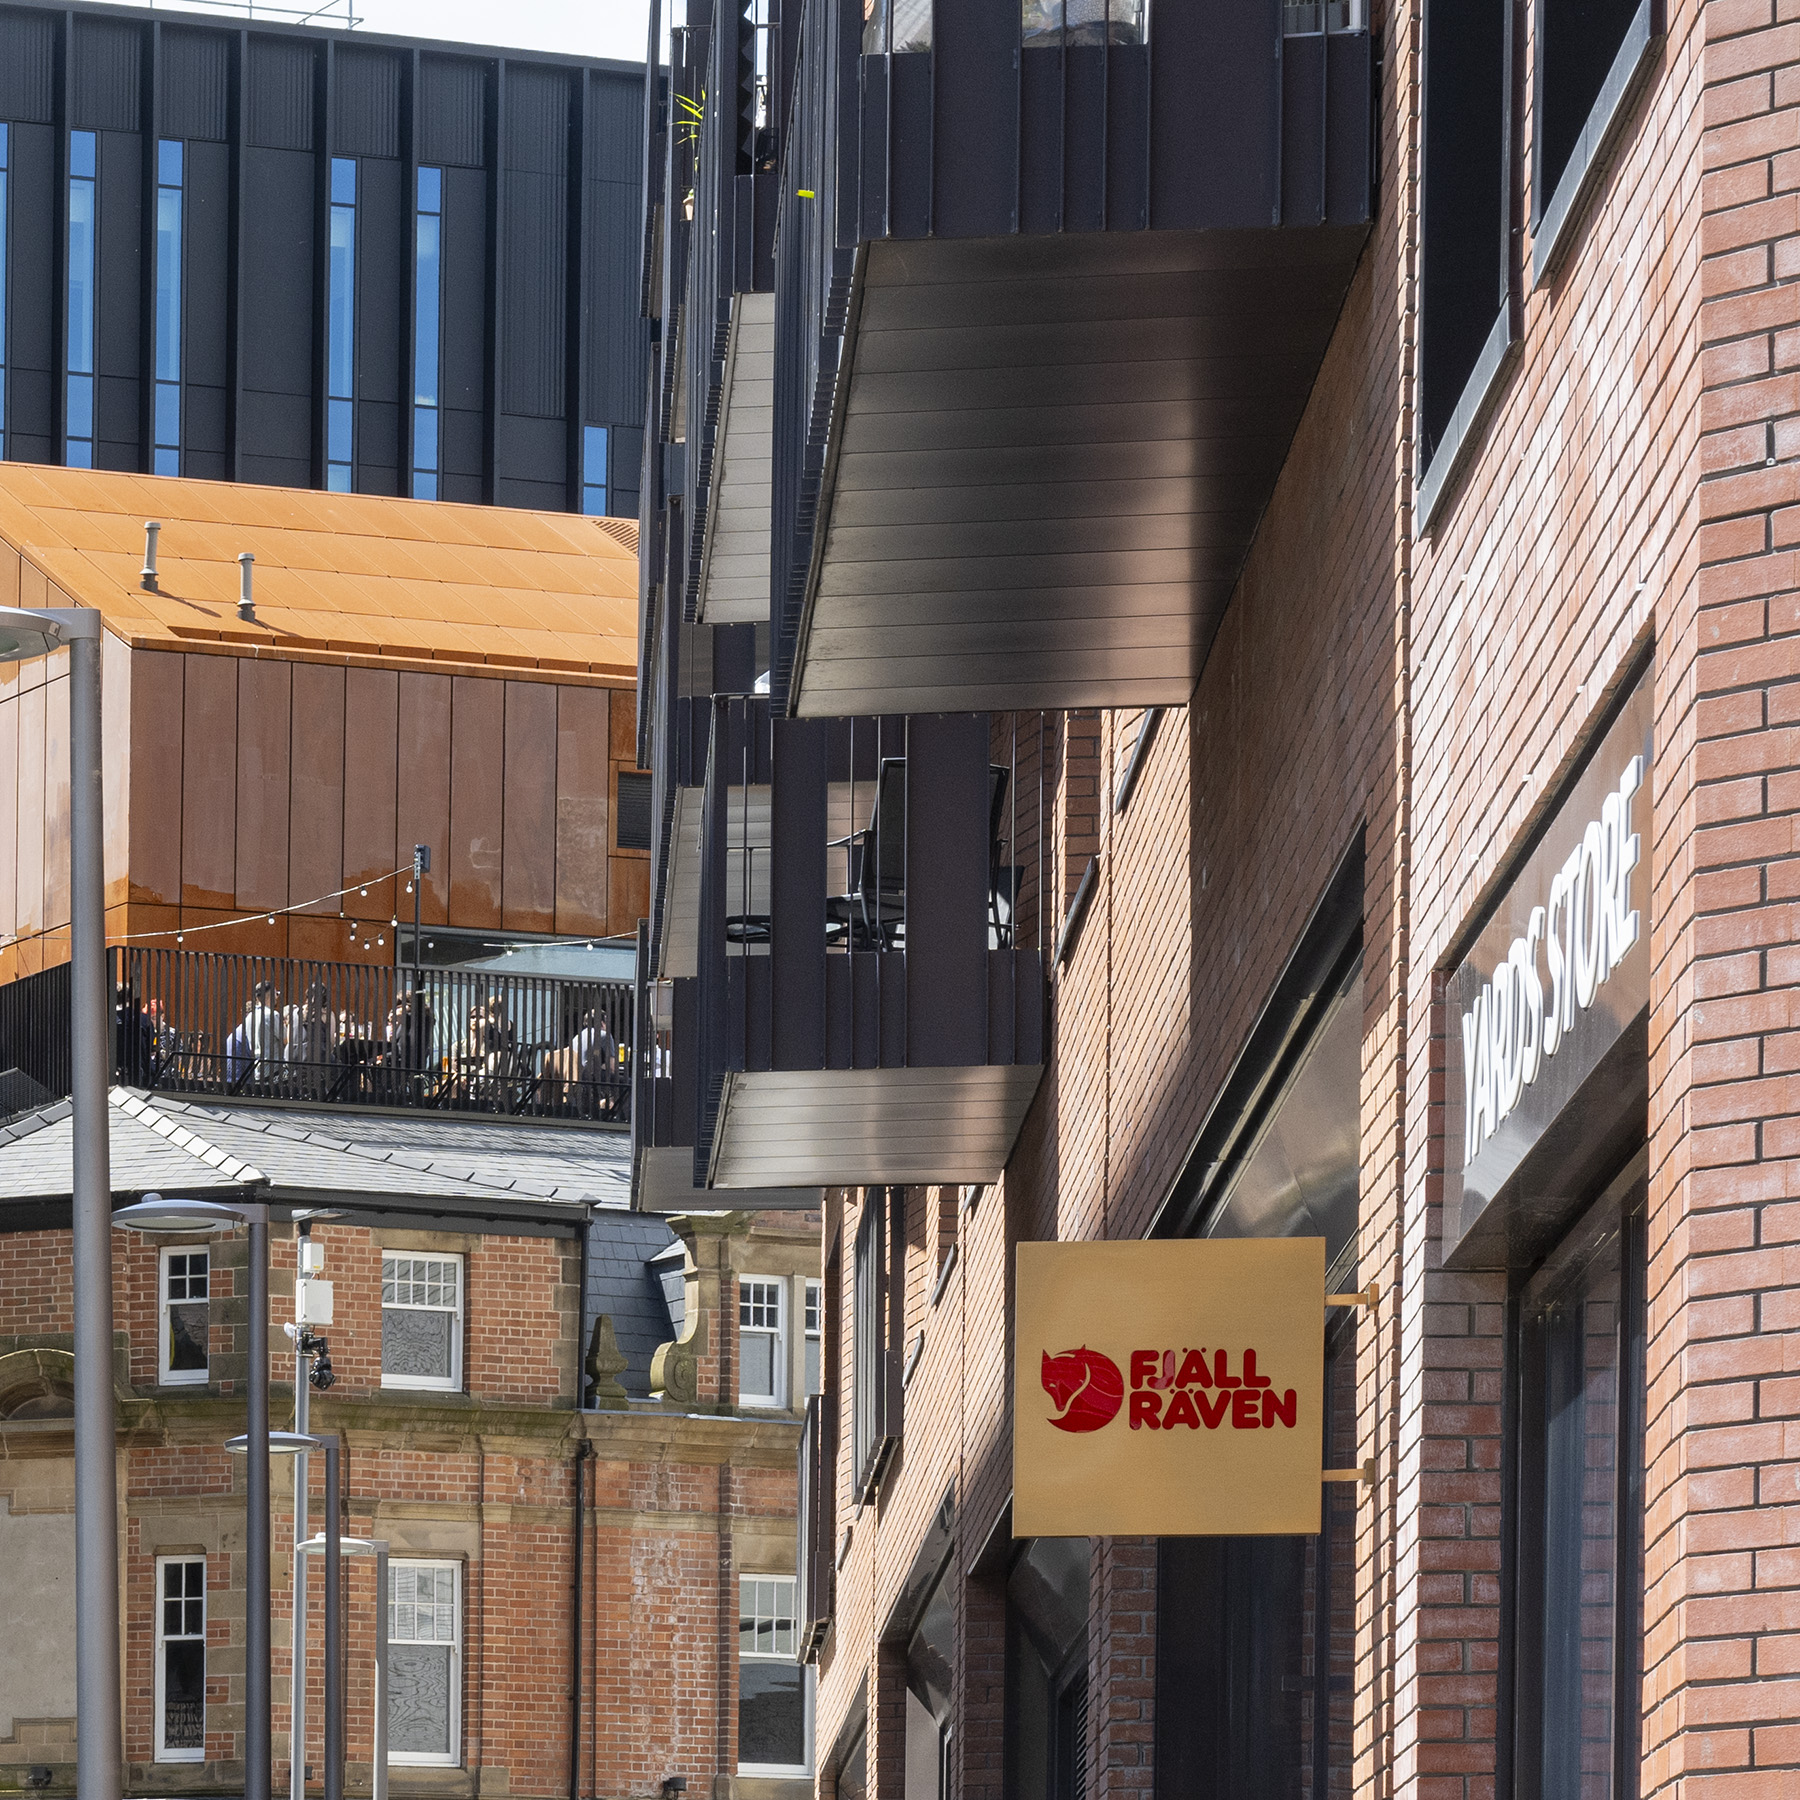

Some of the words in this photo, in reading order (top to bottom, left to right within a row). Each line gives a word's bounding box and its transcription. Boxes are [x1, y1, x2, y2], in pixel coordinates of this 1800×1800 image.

[1462, 906, 1545, 1167] YARDS
[1543, 755, 1644, 1057] STORE
[1130, 1347, 1272, 1390] FJÄLL
[1128, 1388, 1298, 1431] RÄVEN
